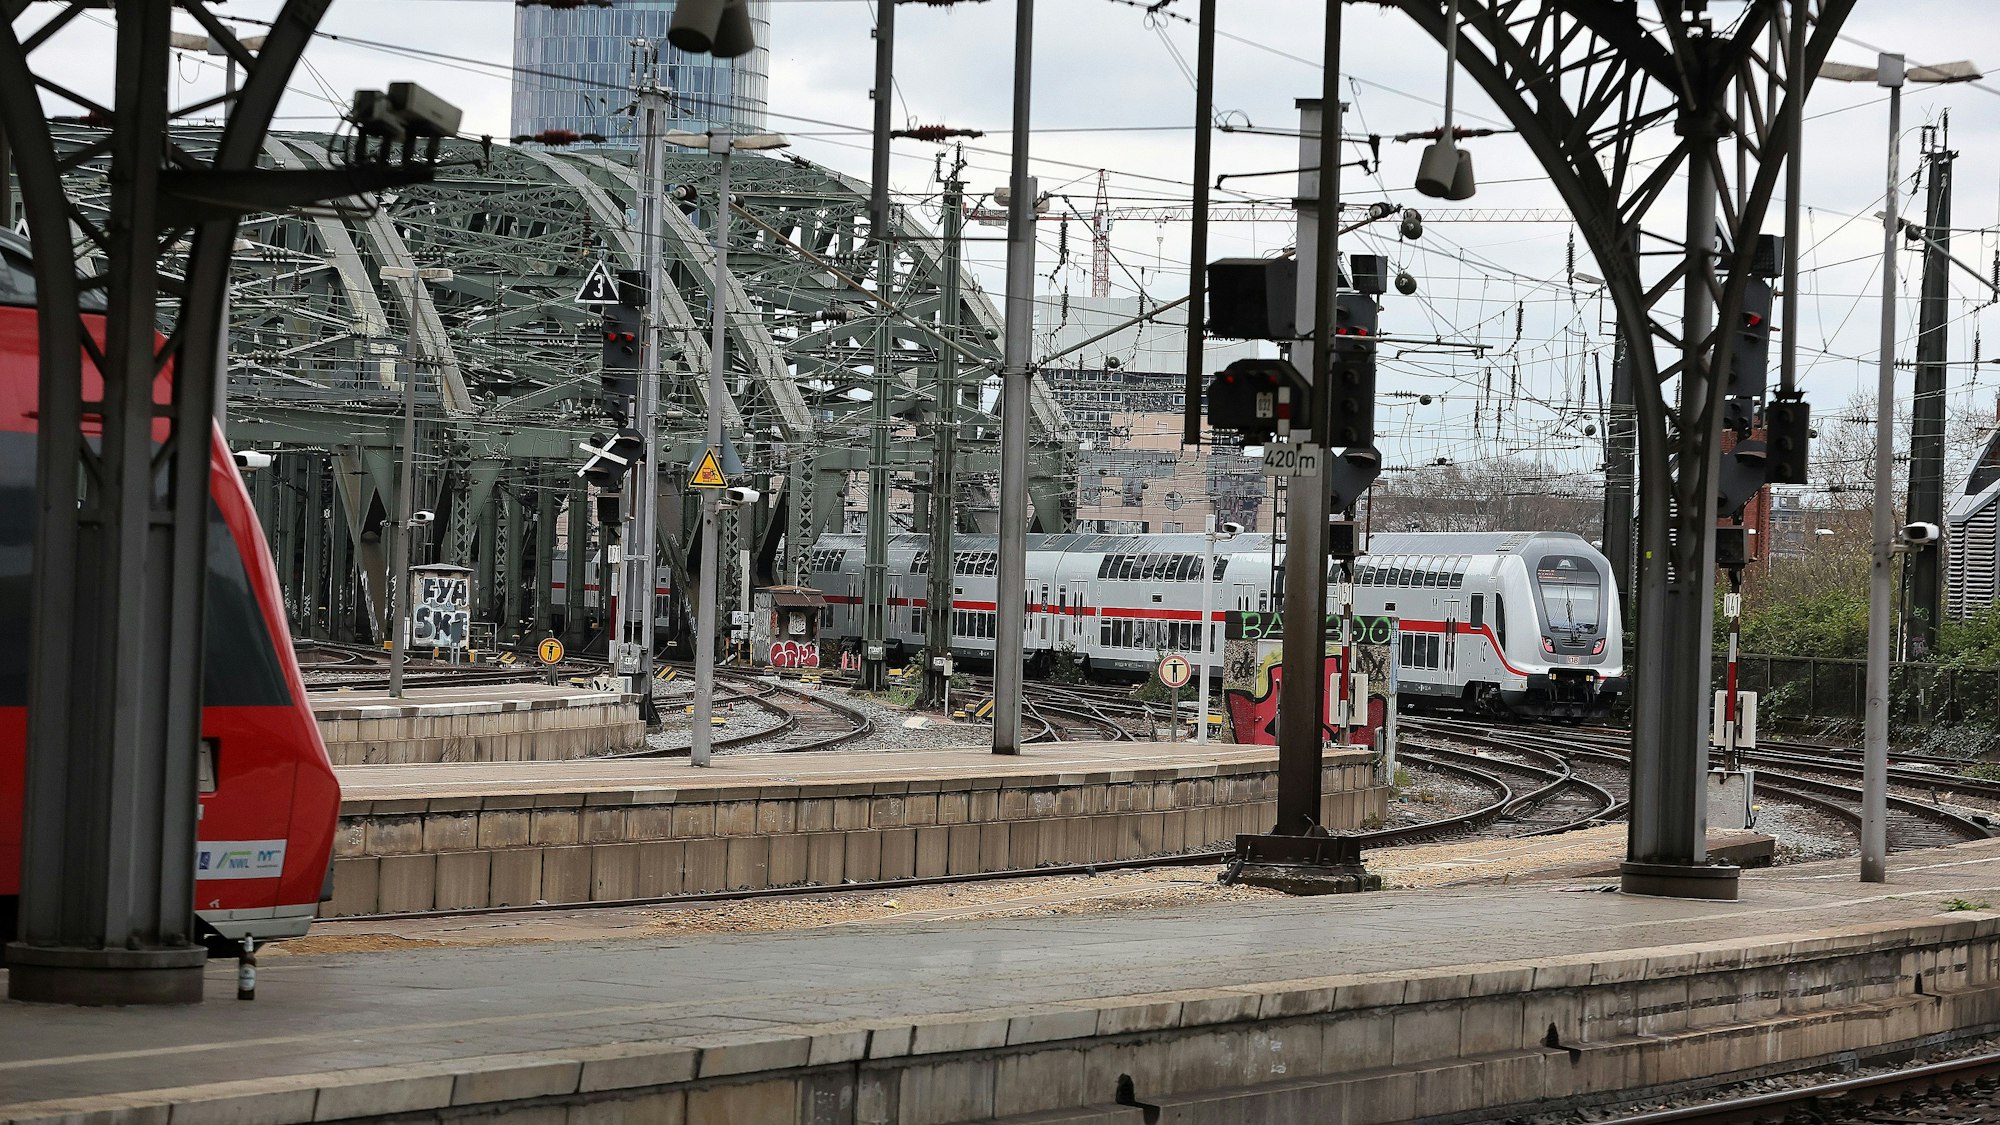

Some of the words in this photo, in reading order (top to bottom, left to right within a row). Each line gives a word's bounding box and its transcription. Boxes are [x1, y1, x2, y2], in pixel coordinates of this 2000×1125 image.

[593, 274, 604, 298] 3
[1264, 450, 1295, 468] 420
[1300, 455, 1316, 469] m
